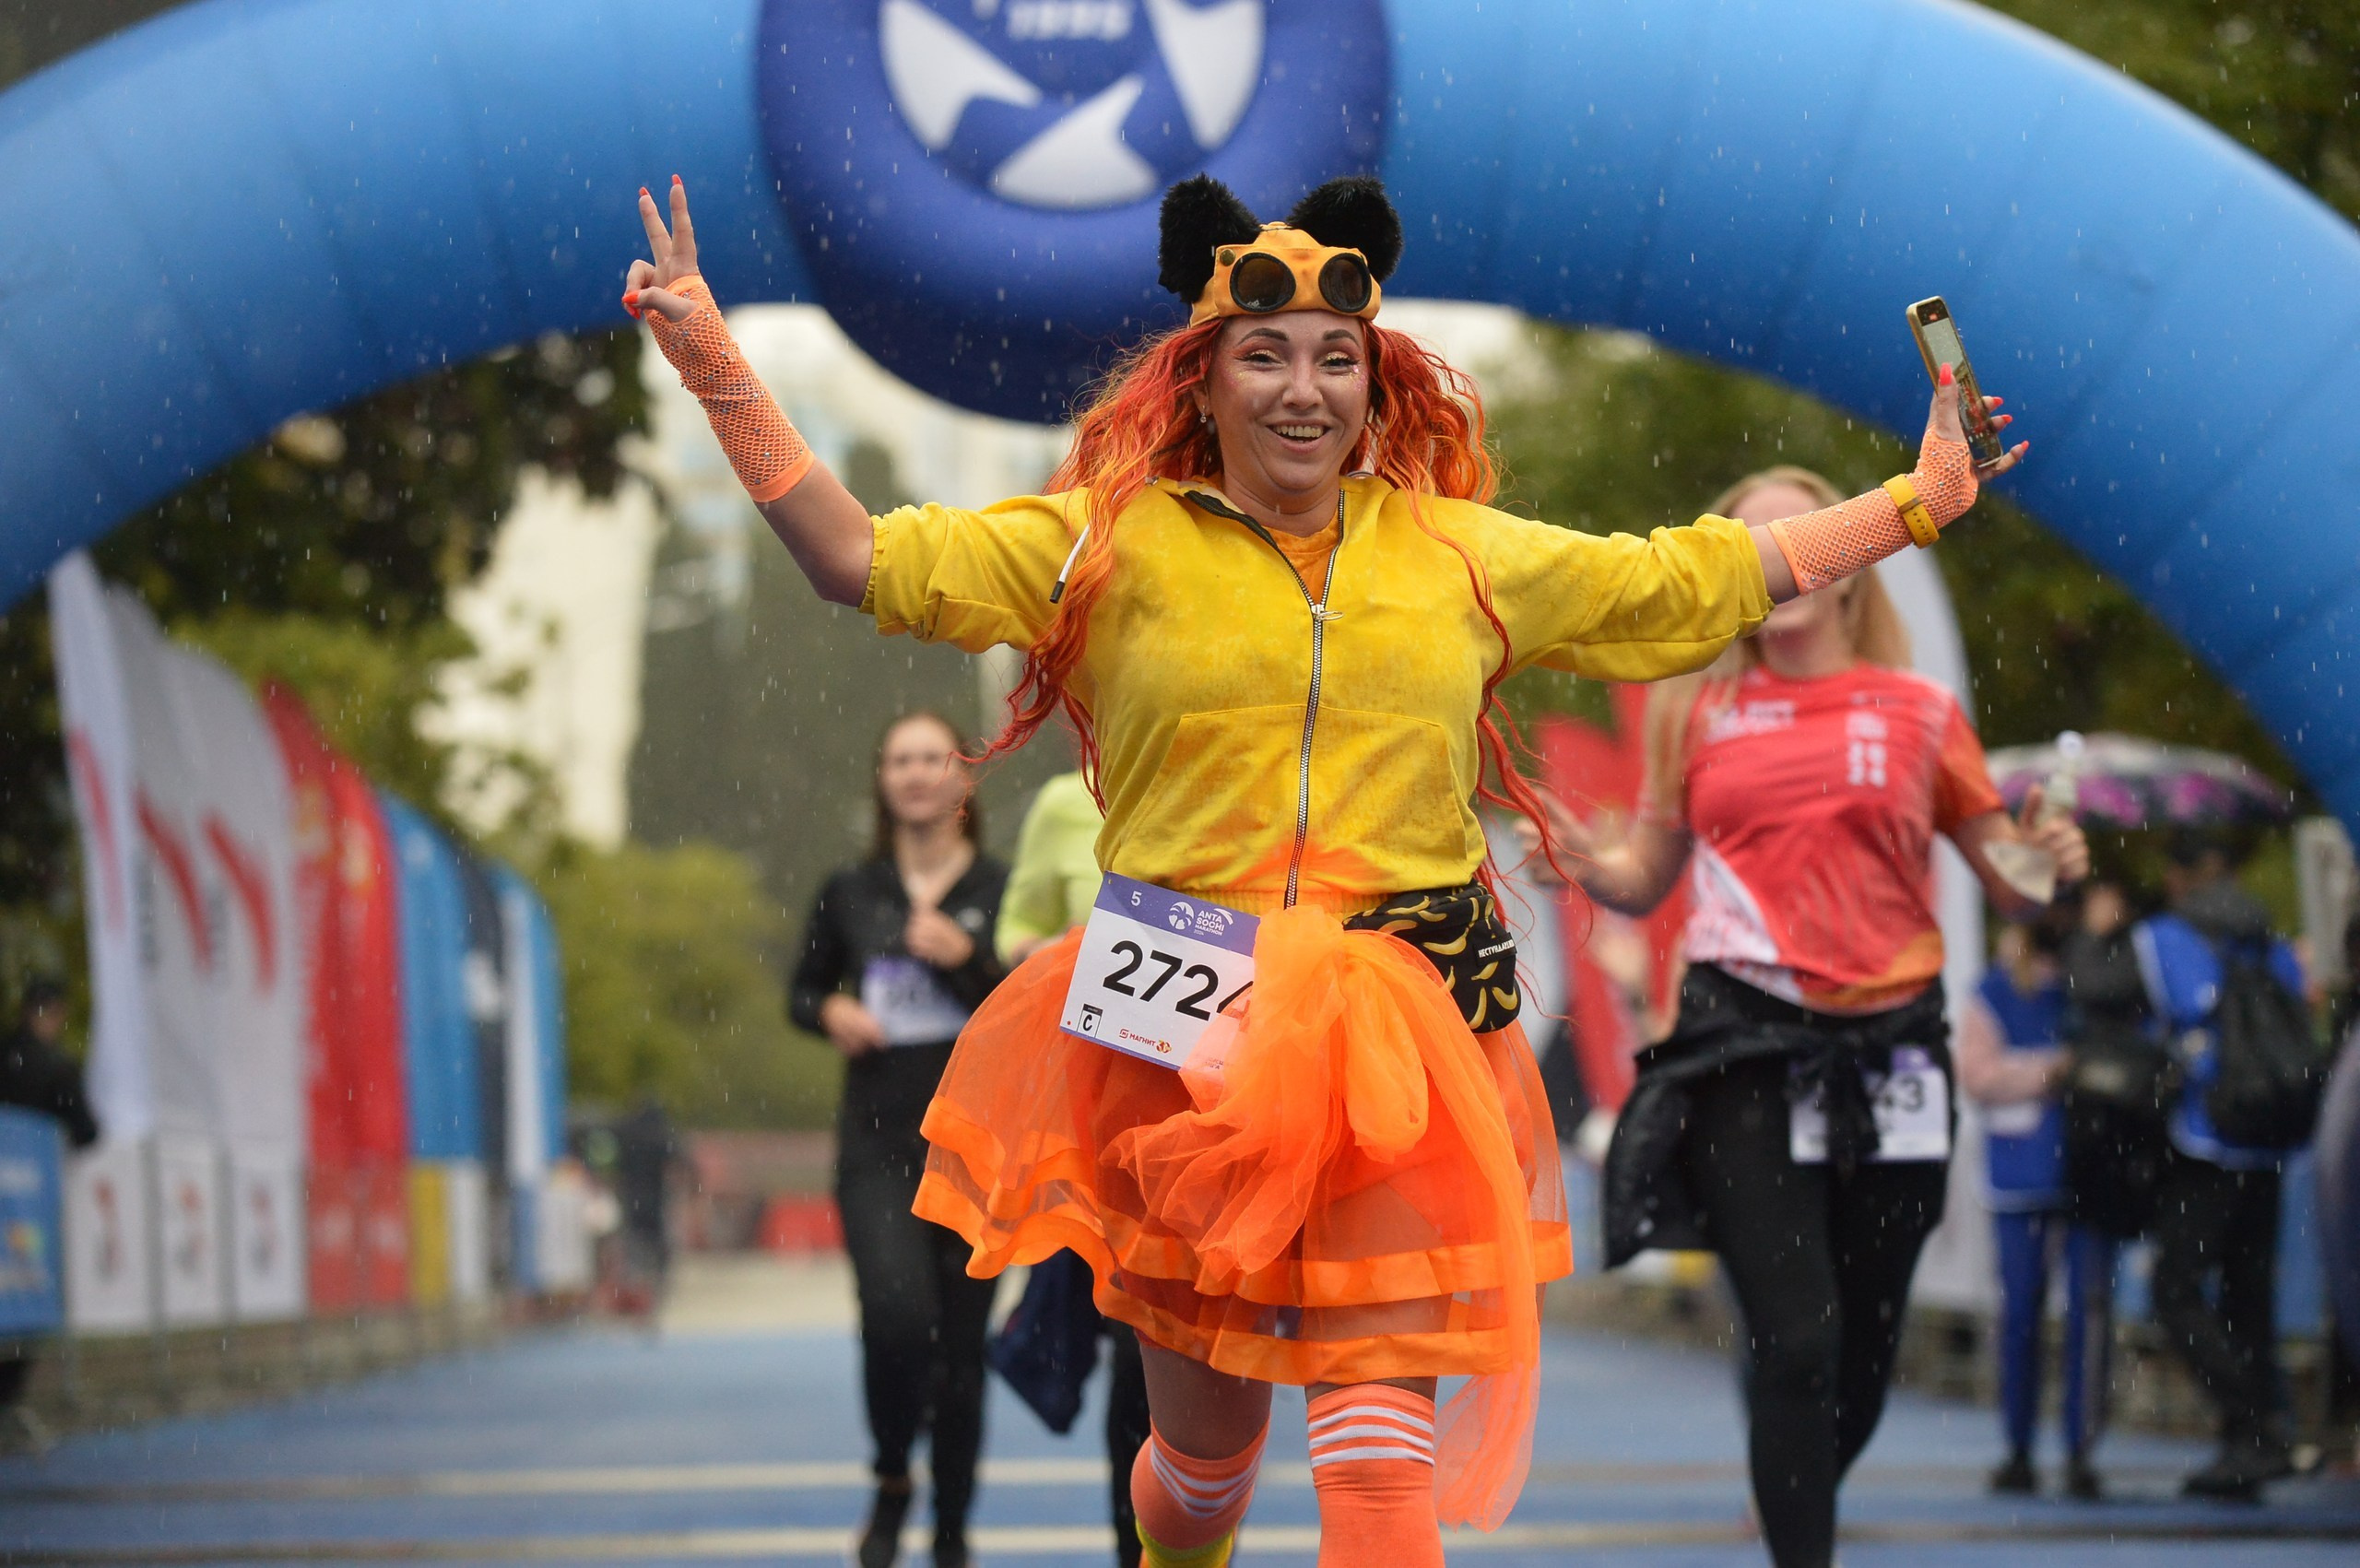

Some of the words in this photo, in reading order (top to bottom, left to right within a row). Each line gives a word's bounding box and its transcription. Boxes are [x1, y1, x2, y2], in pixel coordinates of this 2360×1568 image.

[1130, 890, 1142, 906] 5
[1198, 910, 1222, 923] ANTA
[1194, 925, 1223, 936] MARATHON
[1196, 917, 1225, 931] SOCHI
[1129, 1032, 1157, 1047] МАГНИТ
